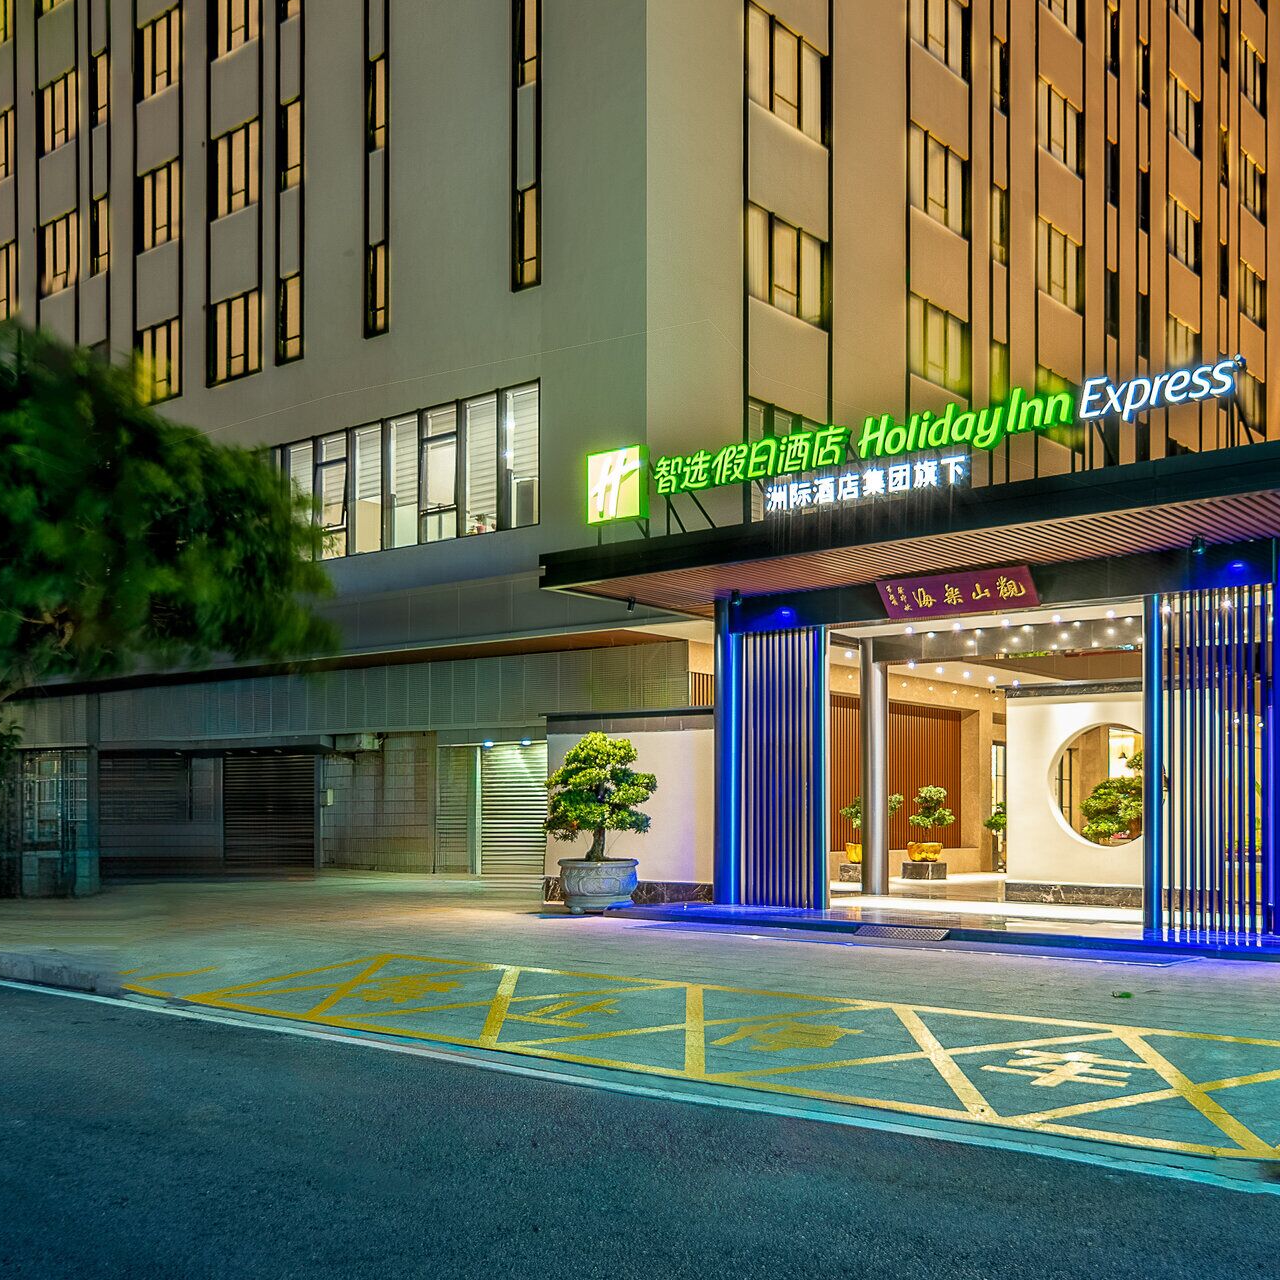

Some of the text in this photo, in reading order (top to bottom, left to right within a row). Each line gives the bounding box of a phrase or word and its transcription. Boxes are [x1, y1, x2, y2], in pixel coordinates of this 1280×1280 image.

[857, 360, 1234, 459] Holiday Inn Express
[654, 425, 848, 494] 智选假日酒店
[766, 455, 966, 512] 洲际酒店集团旗下
